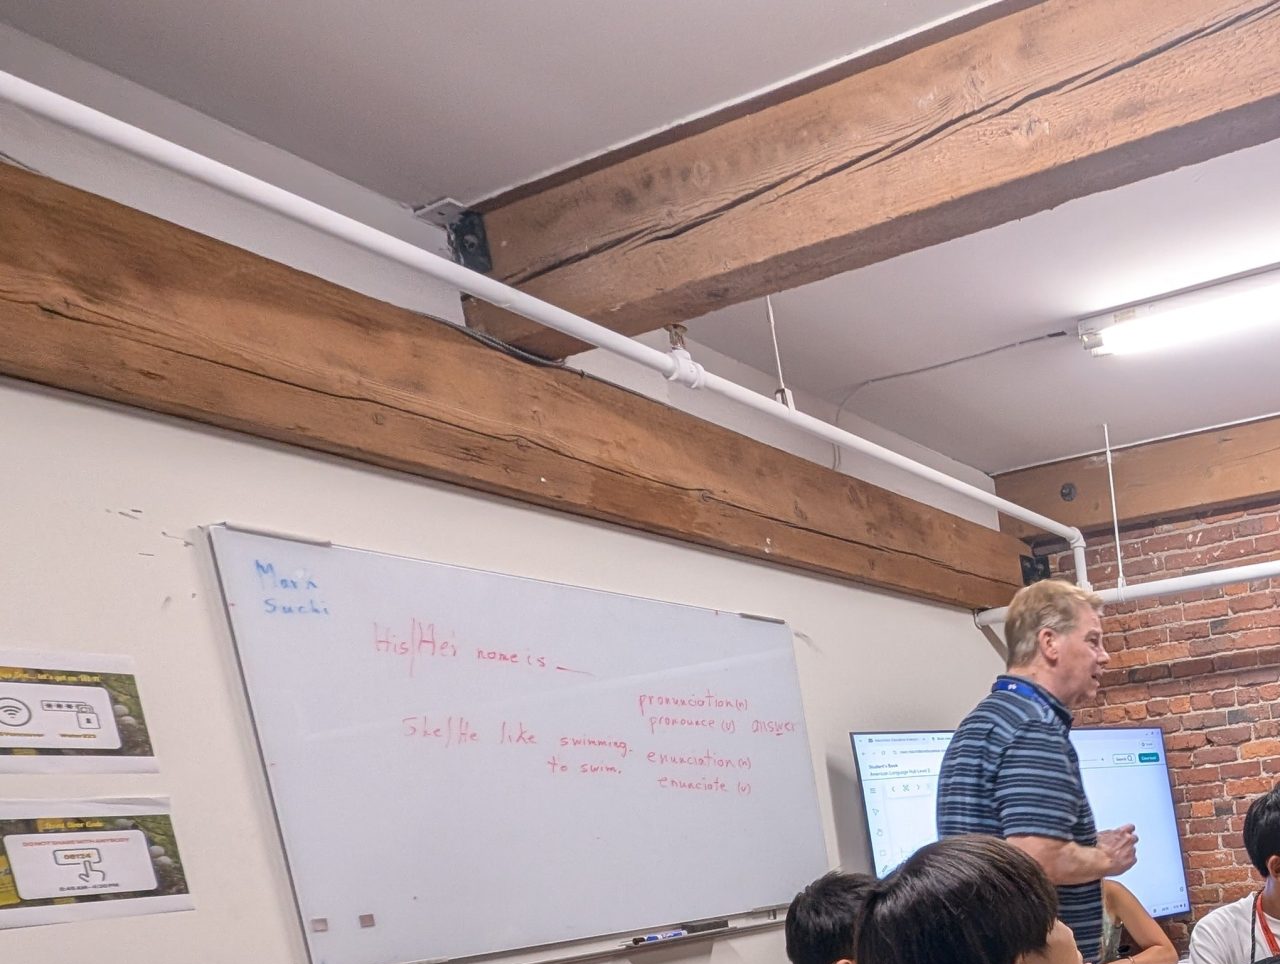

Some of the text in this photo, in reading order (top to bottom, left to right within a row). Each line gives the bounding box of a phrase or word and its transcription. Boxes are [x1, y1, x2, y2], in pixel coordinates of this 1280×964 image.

[527, 649, 546, 668] is
[500, 721, 537, 744] like
[650, 716, 716, 734] pronounce
[752, 719, 797, 736] answer
[547, 756, 568, 773] to
[657, 776, 729, 792] enunciate
